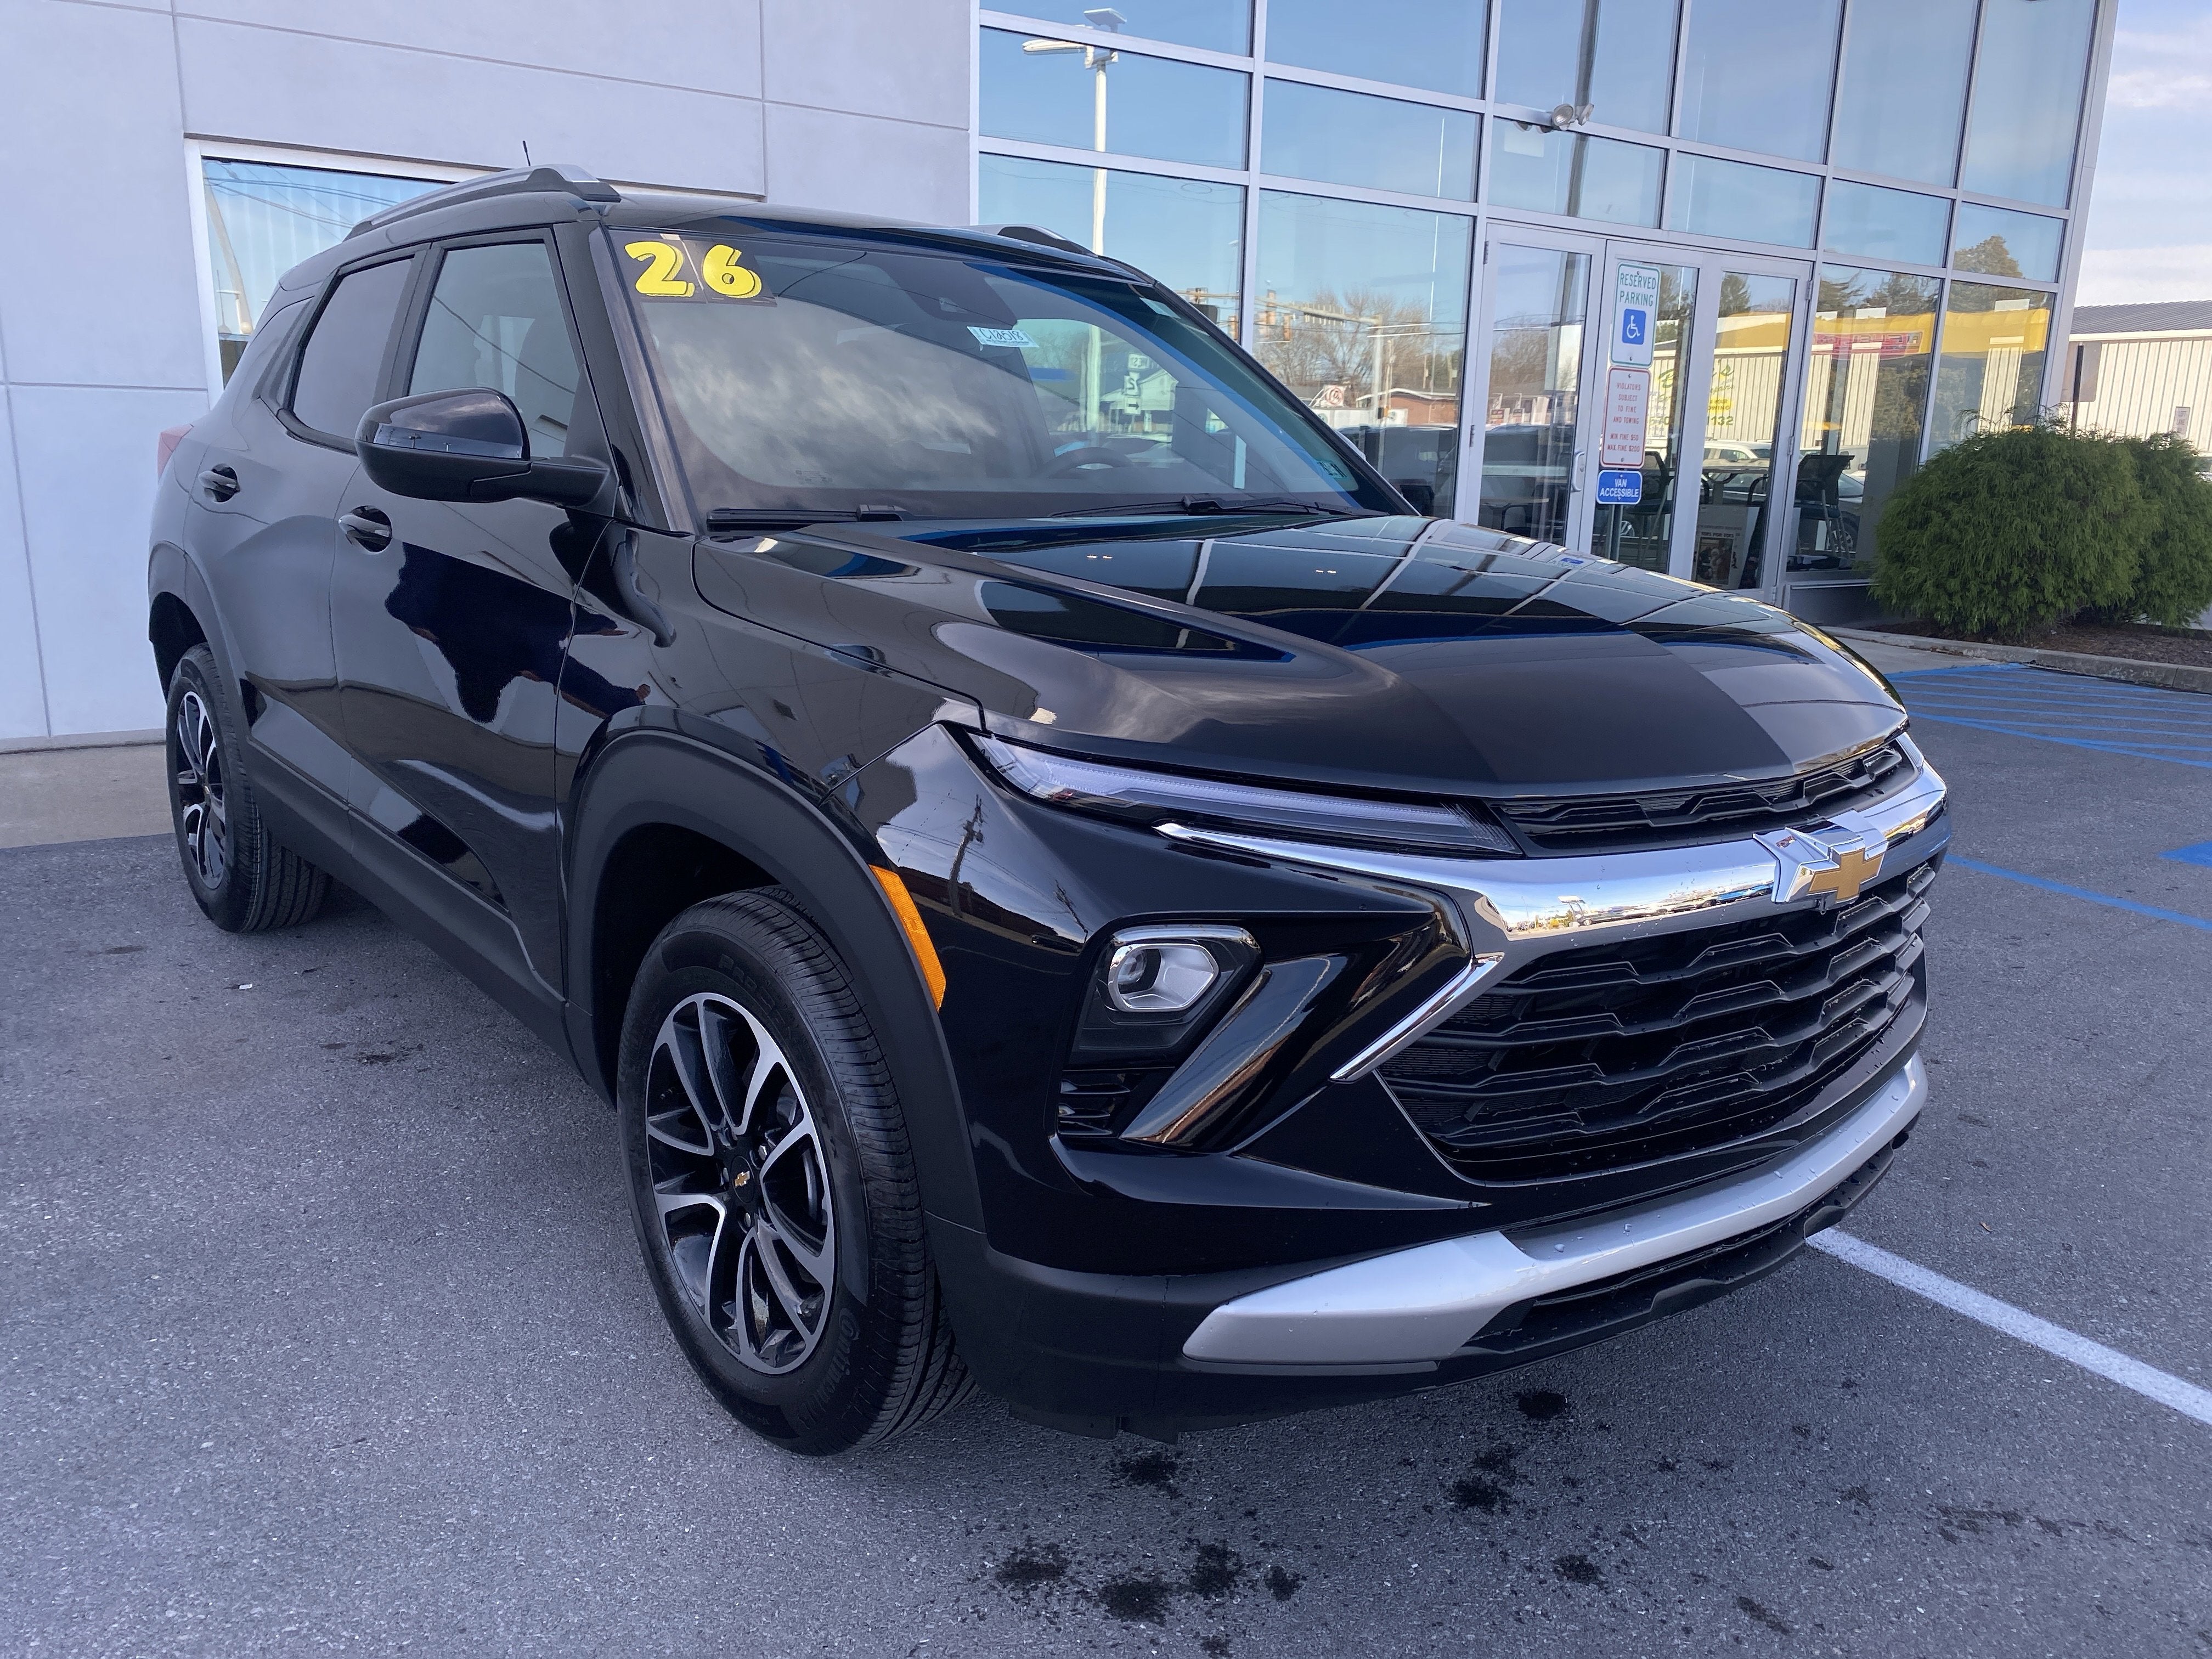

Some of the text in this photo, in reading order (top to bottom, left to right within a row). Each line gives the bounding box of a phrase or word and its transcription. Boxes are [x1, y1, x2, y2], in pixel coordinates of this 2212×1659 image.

[624, 241, 762, 298] 26
[1619, 273, 1656, 290] RESERVED
[1620, 290, 1654, 307] PARKING
[1617, 382, 1641, 391] VIOLATORS
[1615, 478, 1627, 488] VAN
[1599, 488, 1639, 498] ACCESSIBLE
